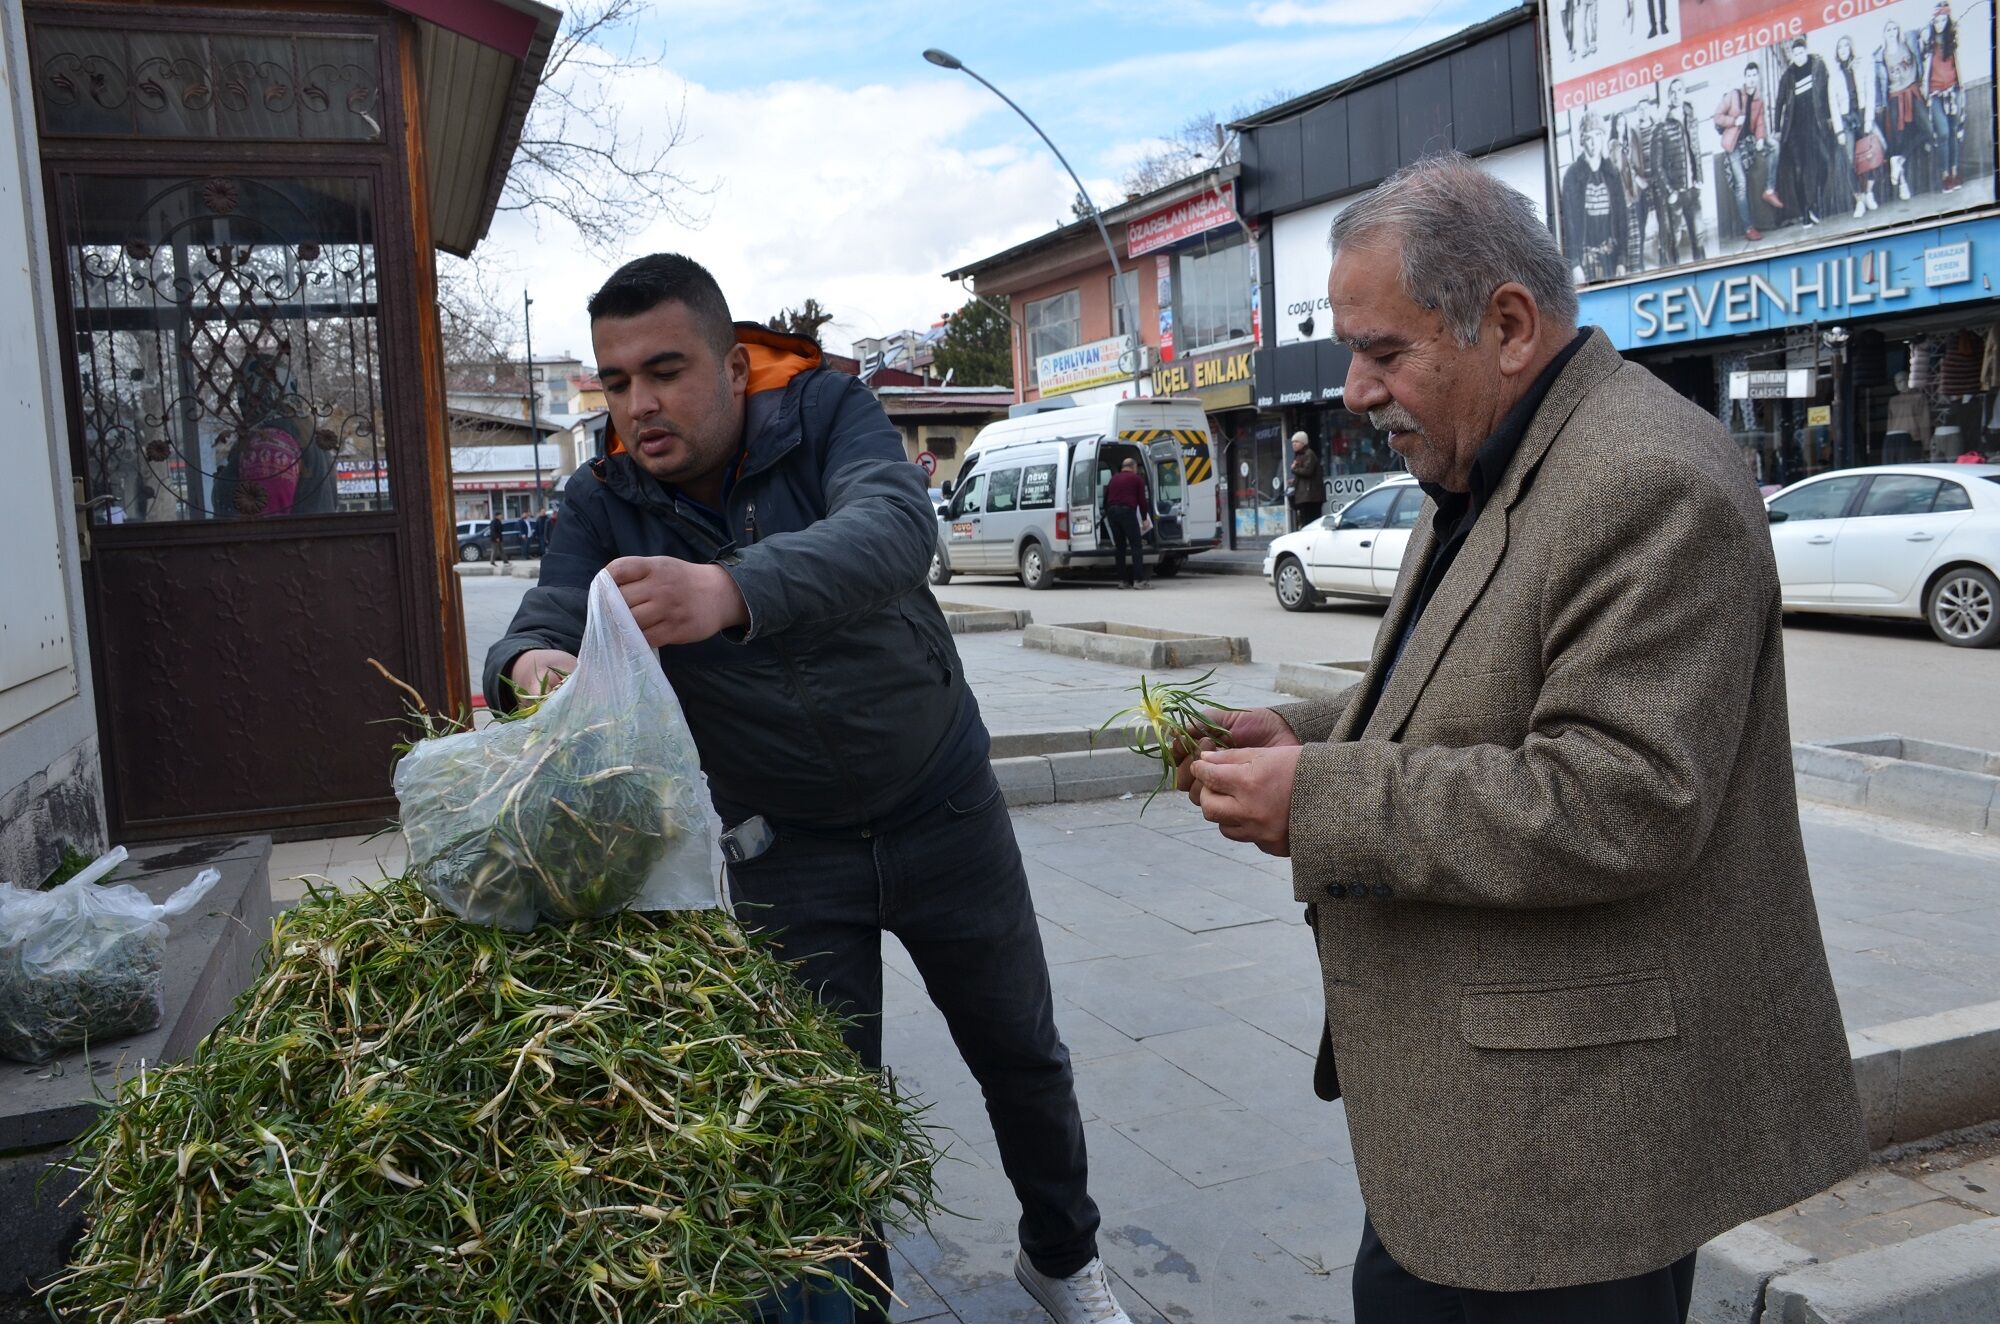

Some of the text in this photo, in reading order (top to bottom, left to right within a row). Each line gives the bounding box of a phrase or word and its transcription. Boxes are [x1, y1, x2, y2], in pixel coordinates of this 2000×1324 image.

[1562, 63, 1665, 108] collezione
[1680, 16, 1803, 70] collezione
[1129, 206, 1187, 242] ÖZARSLAN
[1287, 297, 1333, 318] copy ce
[1053, 346, 1101, 373] PEHLİVAN
[1152, 367, 1190, 399] ÜÇEL
[1194, 352, 1251, 388] EMLAK
[1322, 385, 1345, 399] fotok
[1749, 386, 1786, 398] CLASSICS
[1324, 478, 1365, 494] neva
